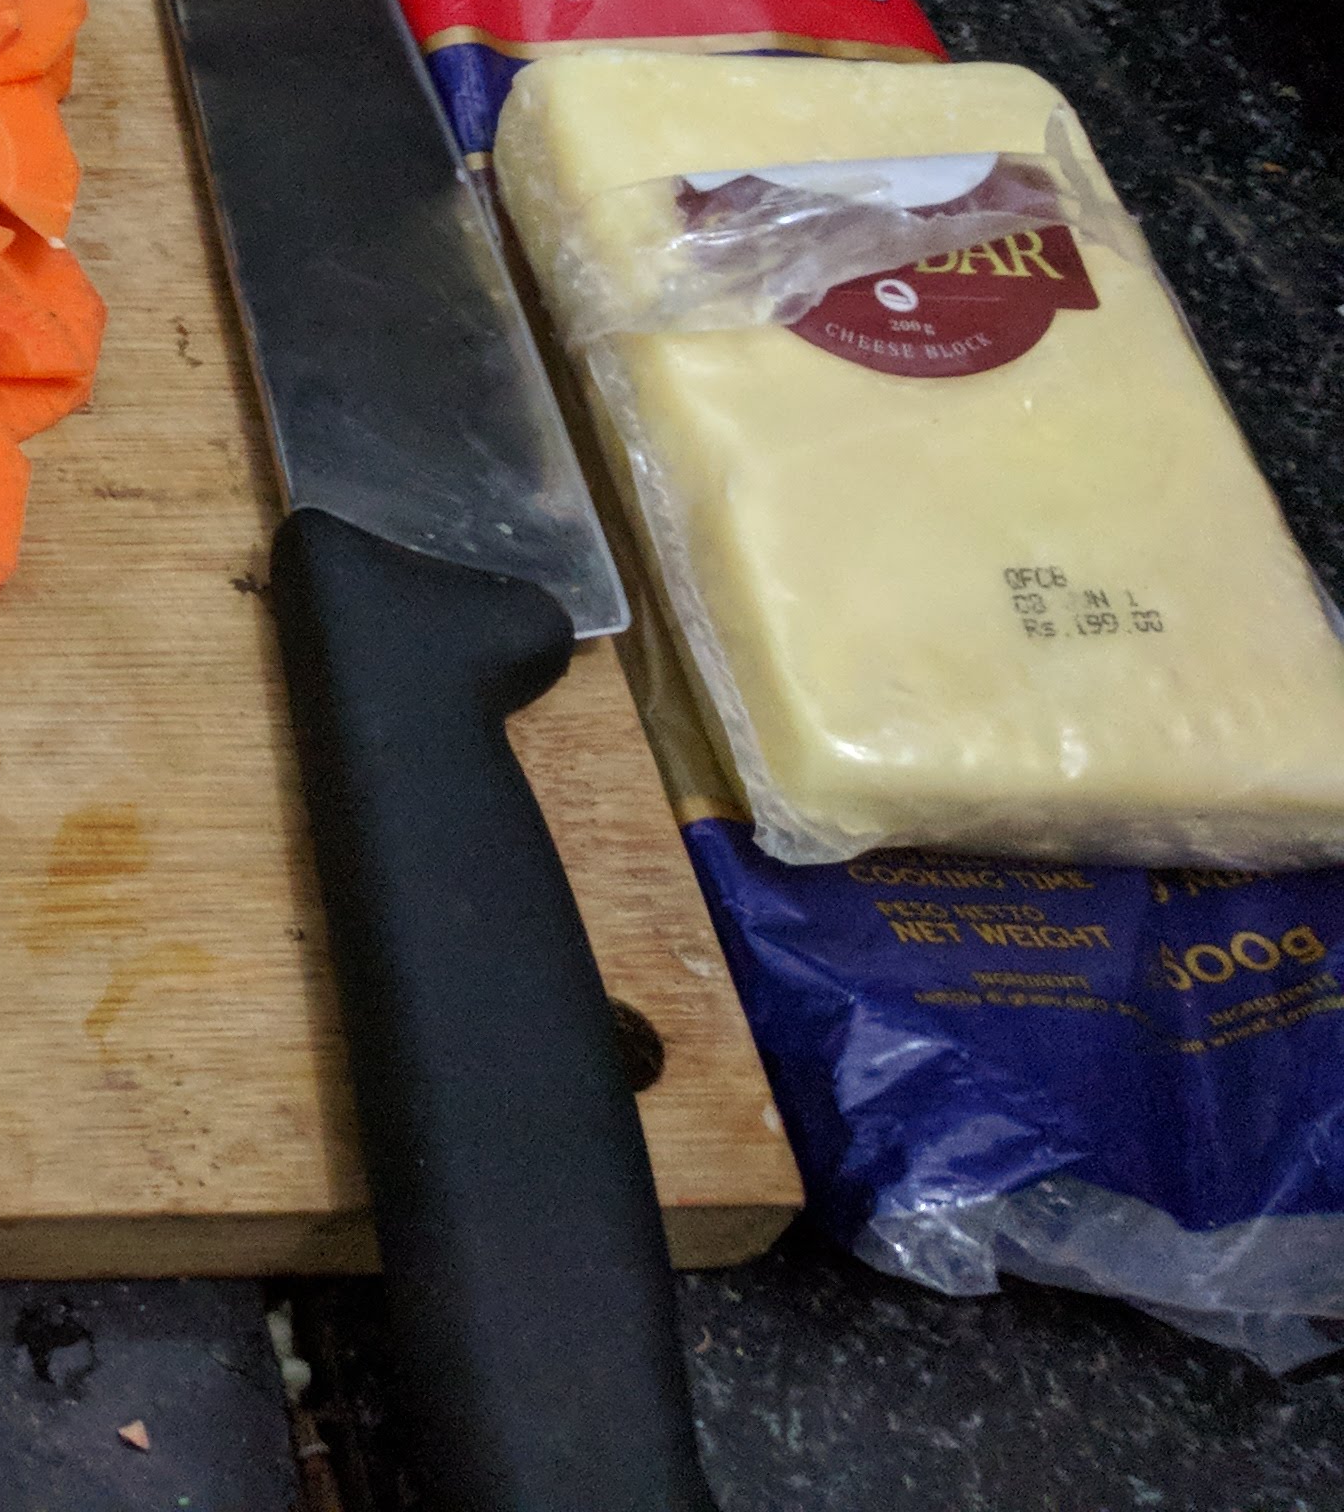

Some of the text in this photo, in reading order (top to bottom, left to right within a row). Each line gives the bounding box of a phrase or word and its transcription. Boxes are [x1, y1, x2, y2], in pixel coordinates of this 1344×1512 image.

[824, 321, 993, 361] CHEESE BLOCK
[847, 862, 1097, 891] COOKING TIME
[888, 920, 1111, 949] NET WEIGHT
